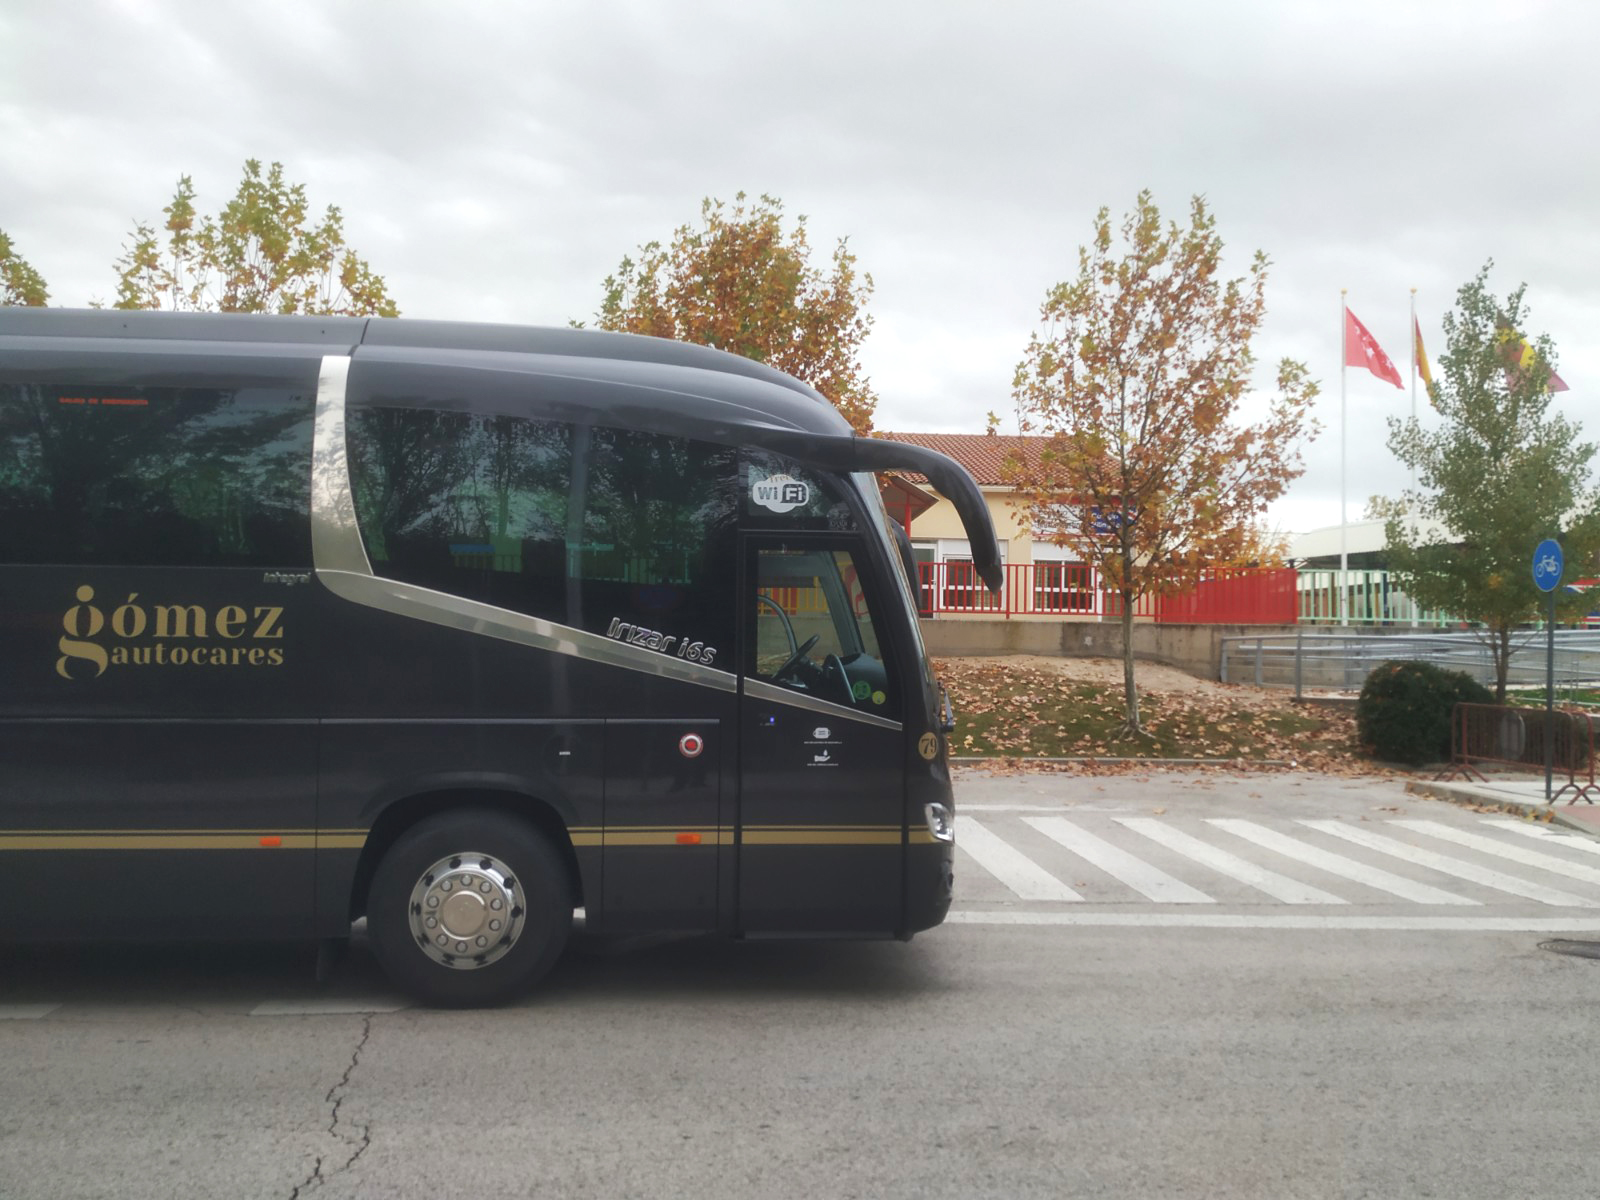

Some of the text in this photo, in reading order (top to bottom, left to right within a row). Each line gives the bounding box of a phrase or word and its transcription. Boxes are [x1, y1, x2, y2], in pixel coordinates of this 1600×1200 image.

[56, 584, 284, 680] gómez
[111, 642, 284, 666] autocares
[677, 637, 717, 665] i6s
[921, 737, 937, 754] 79
